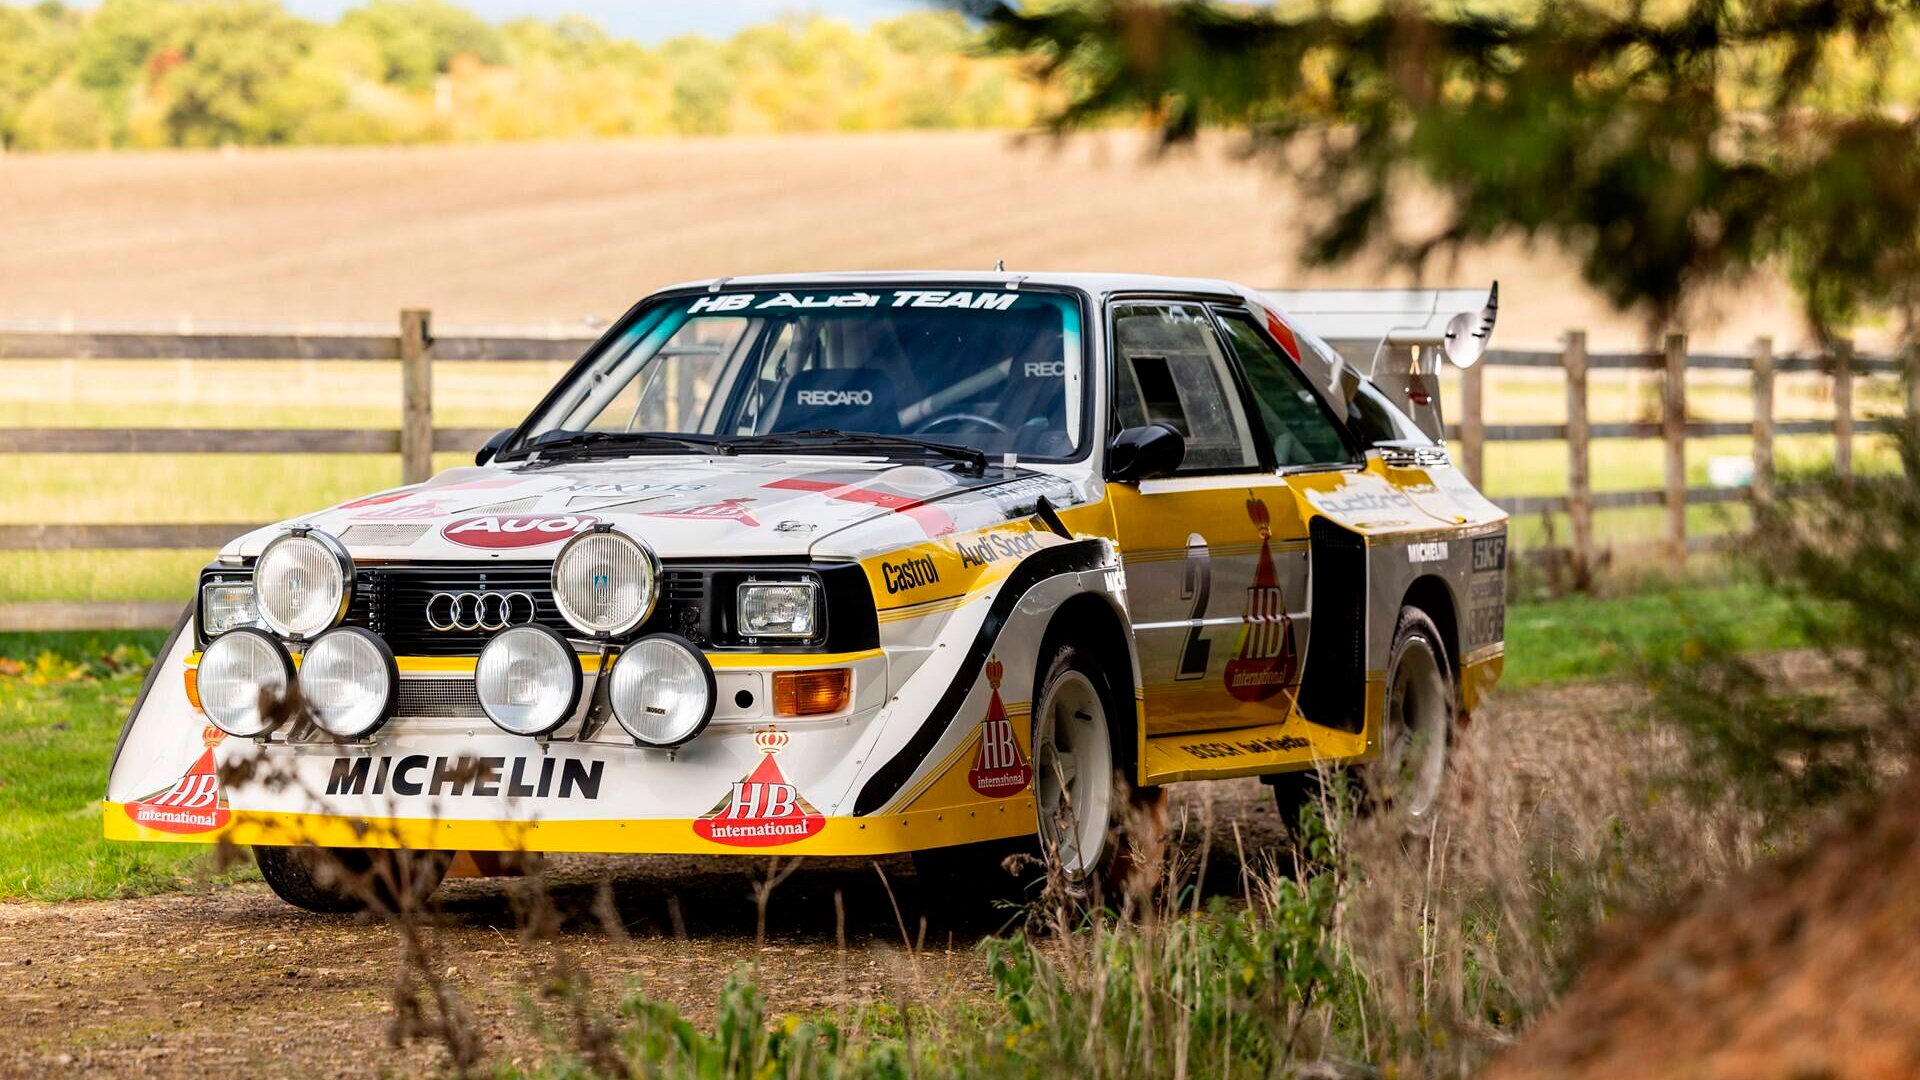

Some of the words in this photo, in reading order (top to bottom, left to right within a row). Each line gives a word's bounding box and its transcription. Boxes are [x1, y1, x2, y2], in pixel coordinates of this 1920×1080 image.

[687, 294, 755, 314] HB
[891, 291, 1020, 310] TEAM
[797, 390, 873, 406] RECARO
[881, 554, 940, 595] Castrol
[955, 537, 999, 569] Audi
[990, 531, 1042, 560] Sport
[1408, 542, 1448, 564] MICHELIN
[1473, 538, 1504, 571] SKF
[1175, 532, 1212, 681] 2
[981, 719, 1016, 770] HB
[153, 774, 220, 808] HB
[325, 754, 605, 800] MICHELIN
[977, 769, 1026, 789] international
[137, 806, 217, 827] international
[726, 782, 798, 819] HB
[710, 818, 809, 838] international
